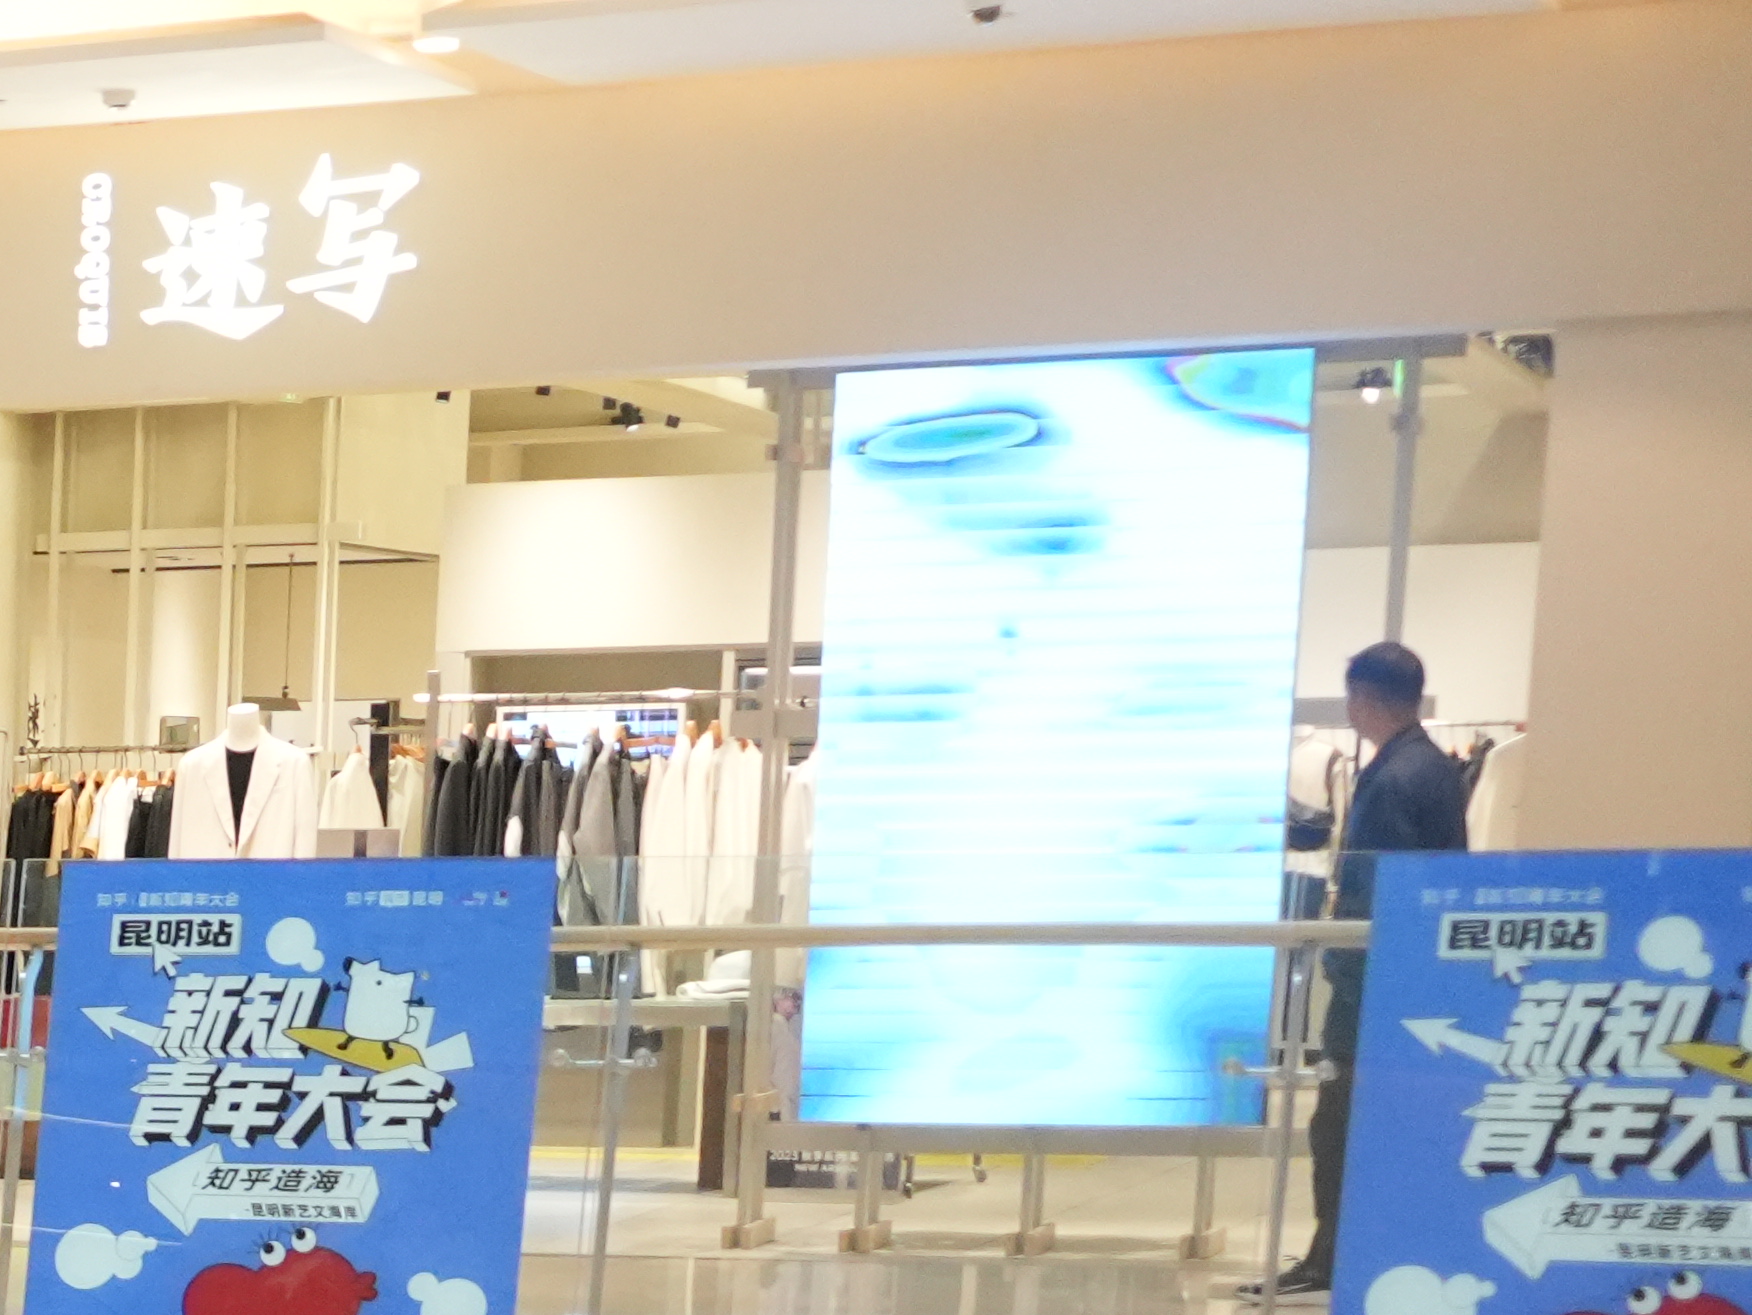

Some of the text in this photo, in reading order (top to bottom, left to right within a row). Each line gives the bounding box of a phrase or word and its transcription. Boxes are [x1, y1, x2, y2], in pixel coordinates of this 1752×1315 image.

[140, 152, 421, 340] 速写
[118, 919, 233, 947] 昆明站
[1448, 918, 1596, 951] 昆明站
[154, 972, 324, 1059] 新知
[1499, 979, 1713, 1077] 新知
[129, 1062, 445, 1151] 青年大会
